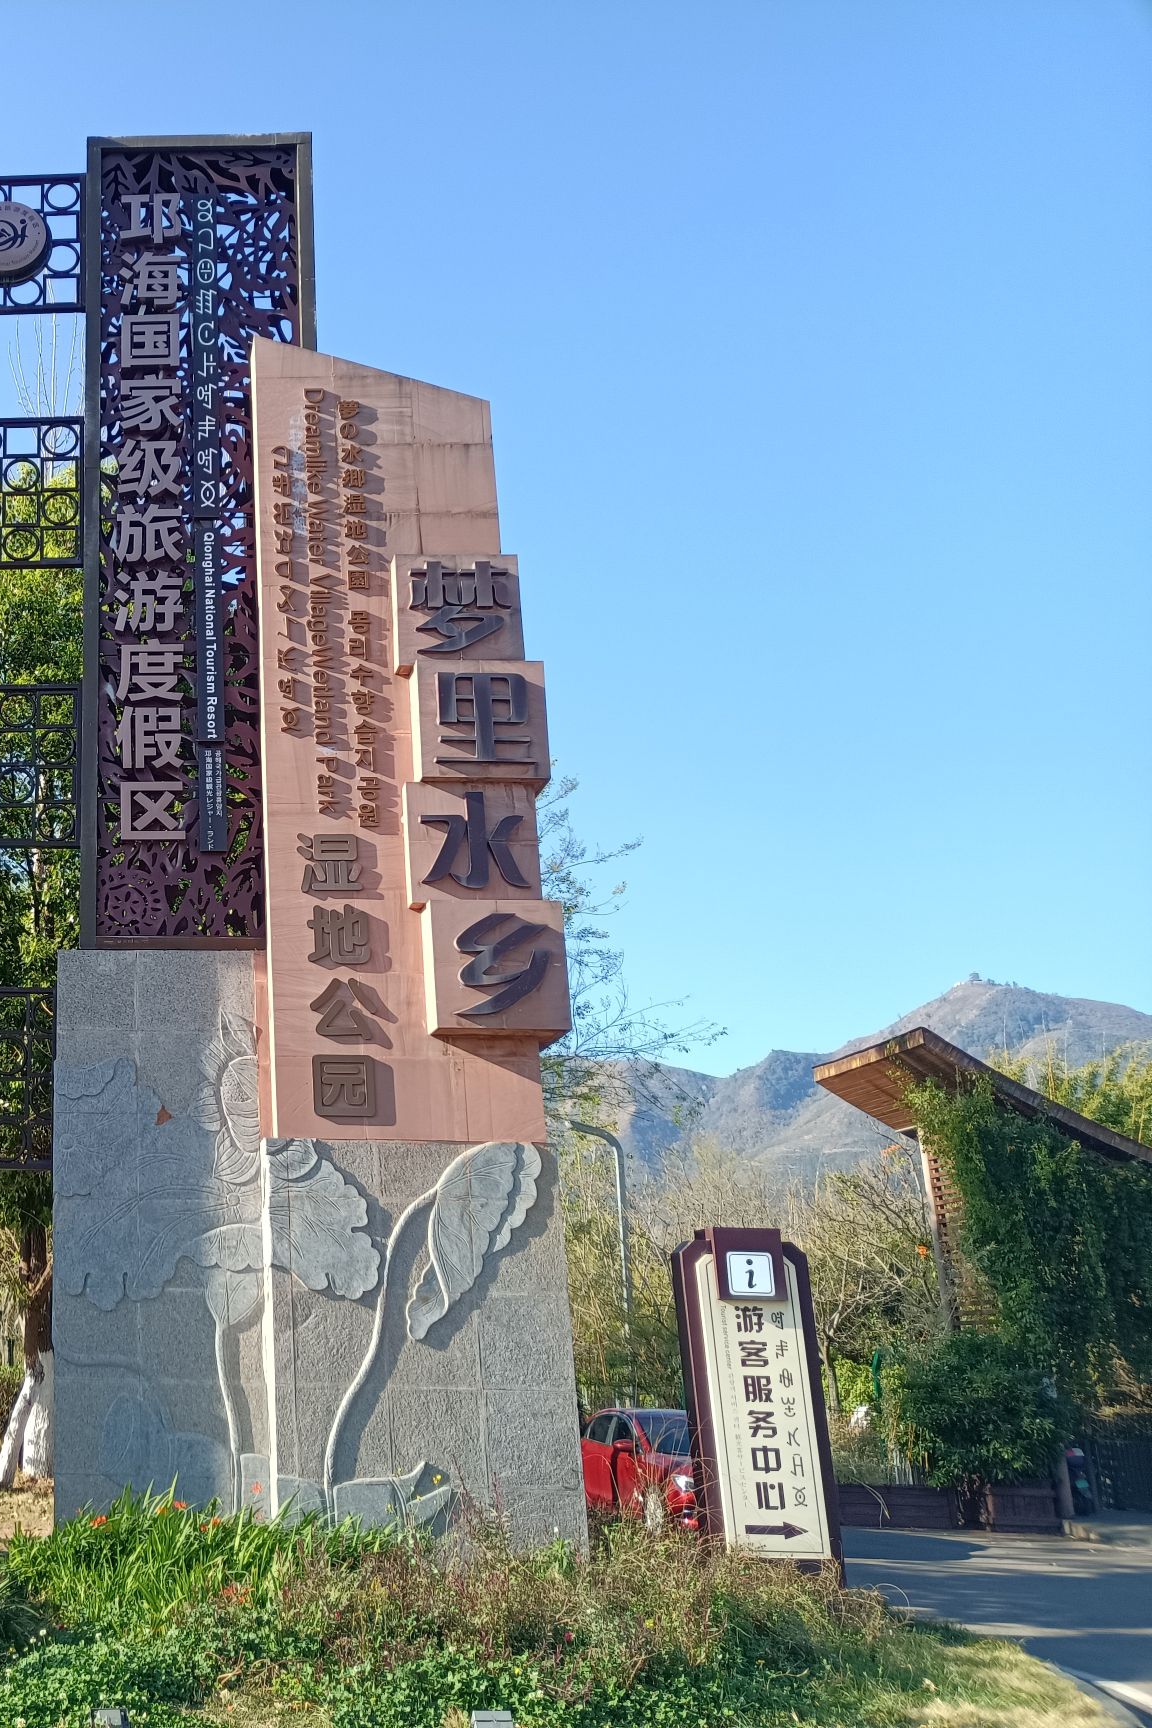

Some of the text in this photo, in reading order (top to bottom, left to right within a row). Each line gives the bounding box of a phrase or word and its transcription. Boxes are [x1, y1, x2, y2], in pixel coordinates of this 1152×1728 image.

[117, 193, 186, 841] 邛海国家级旅游度假区
[302, 387, 326, 494] Dreamlike
[306, 498, 328, 566] Water
[202, 531, 218, 740] Qionghai National Tourism Resort
[316, 755, 336, 813] Park
[408, 561, 551, 1017] 梦里水乡
[296, 833, 378, 1117] 湿地公园
[734, 1305, 787, 1511] 游客服务中心
